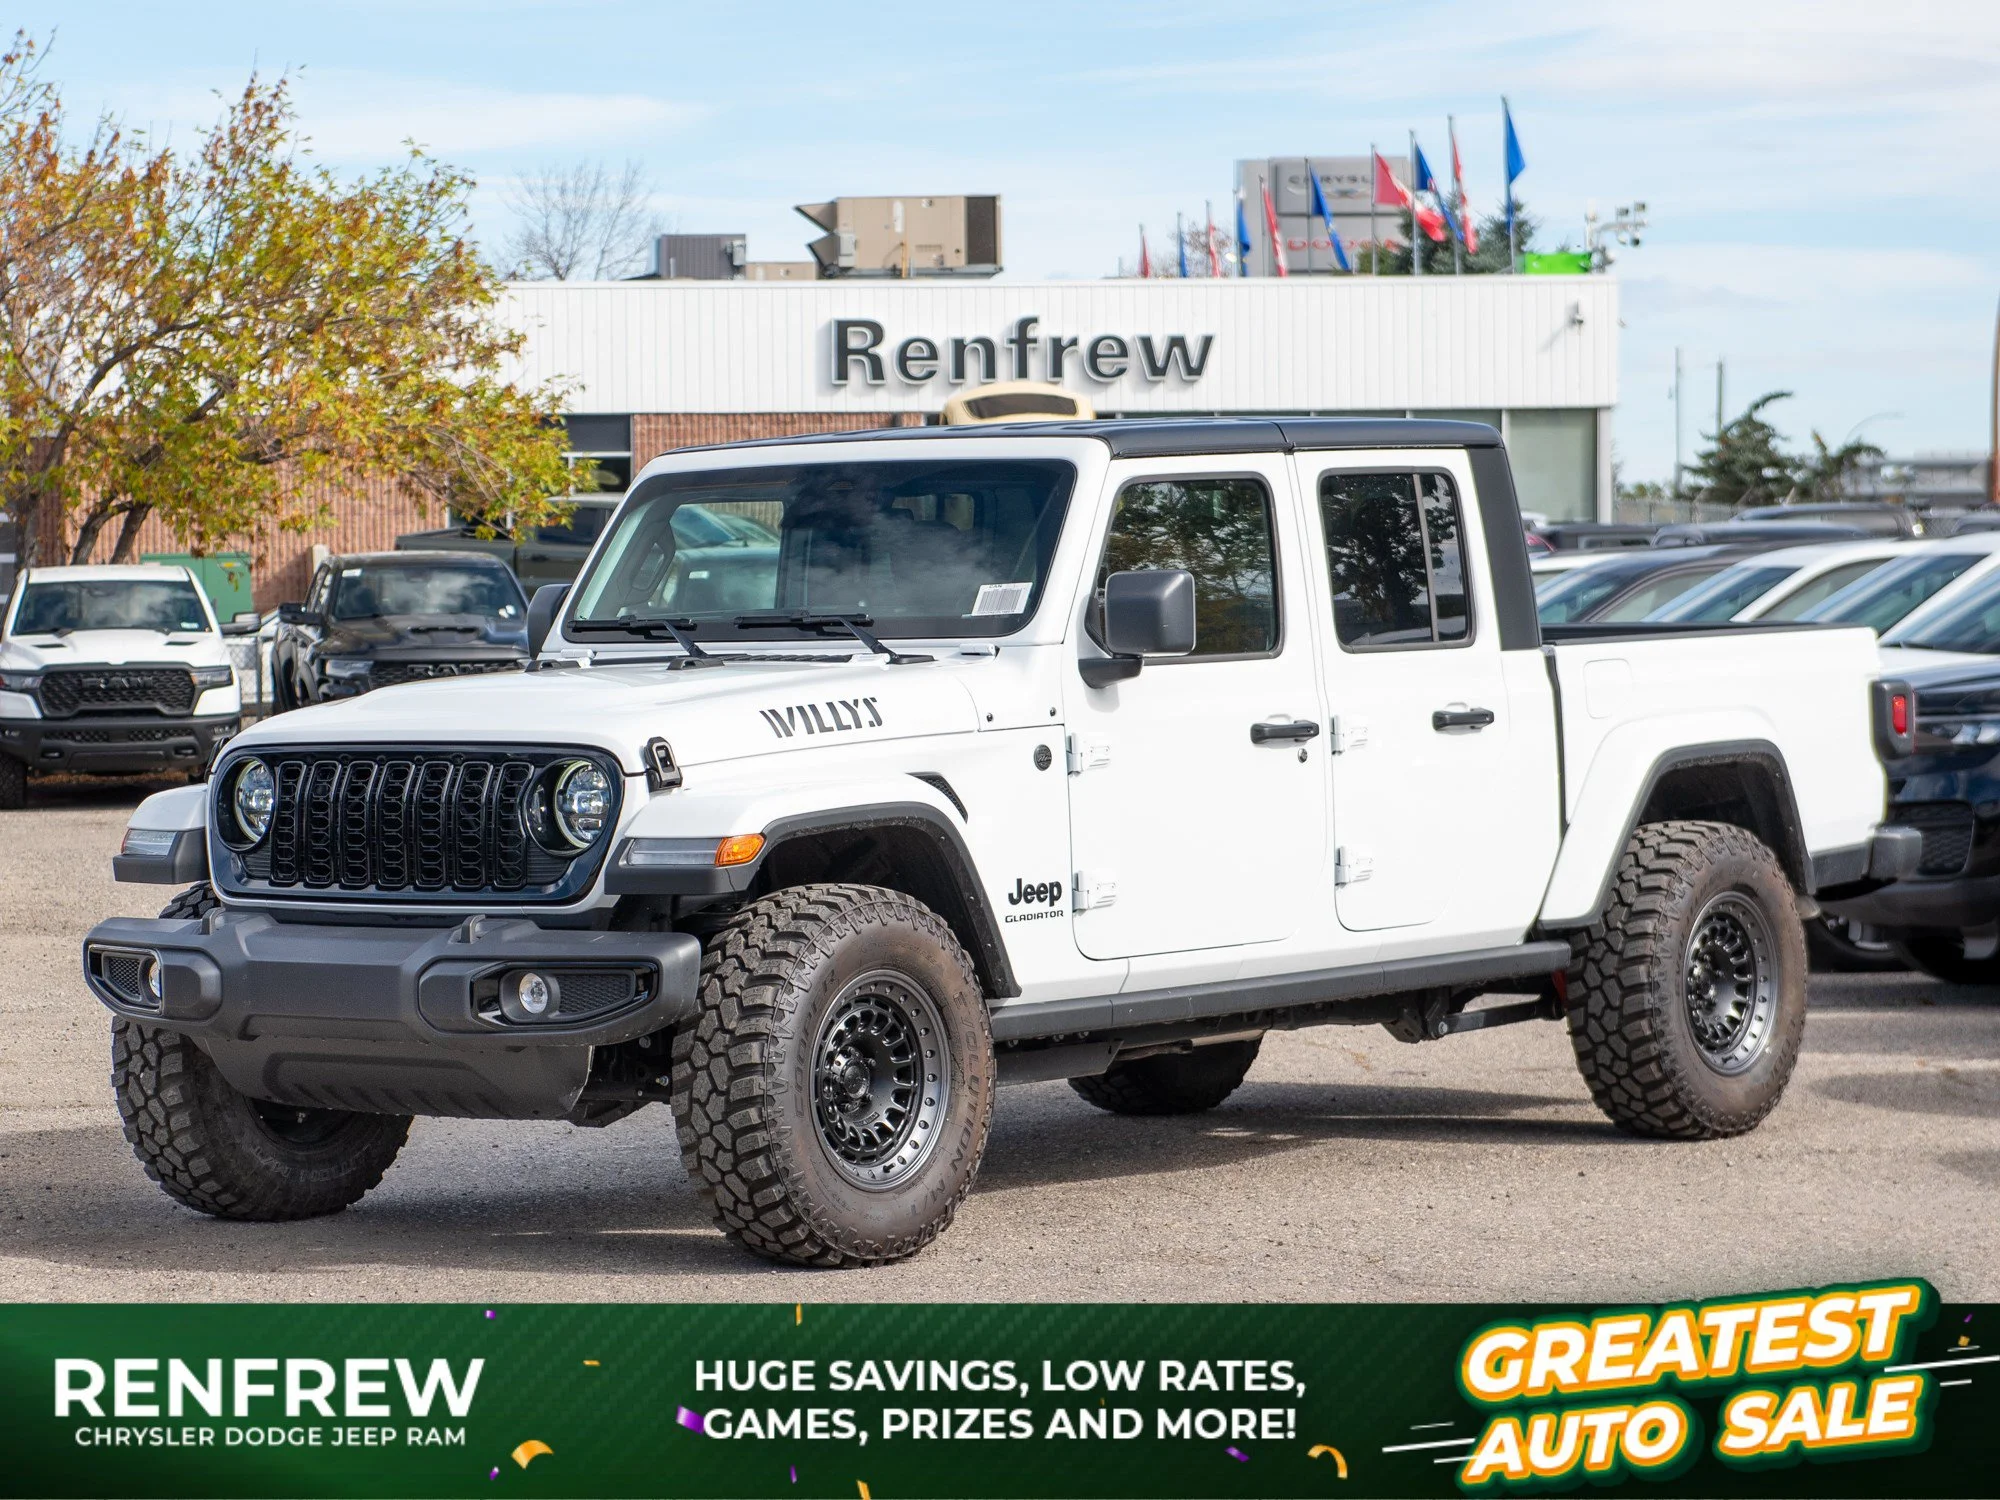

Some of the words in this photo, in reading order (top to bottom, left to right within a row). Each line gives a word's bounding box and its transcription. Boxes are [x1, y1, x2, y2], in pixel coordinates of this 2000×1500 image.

[832, 315, 1215, 385] Renfrew
[759, 697, 883, 738] WILLYS
[1007, 877, 1063, 908] Jeep
[1004, 909, 1064, 923] GLADIATOR
